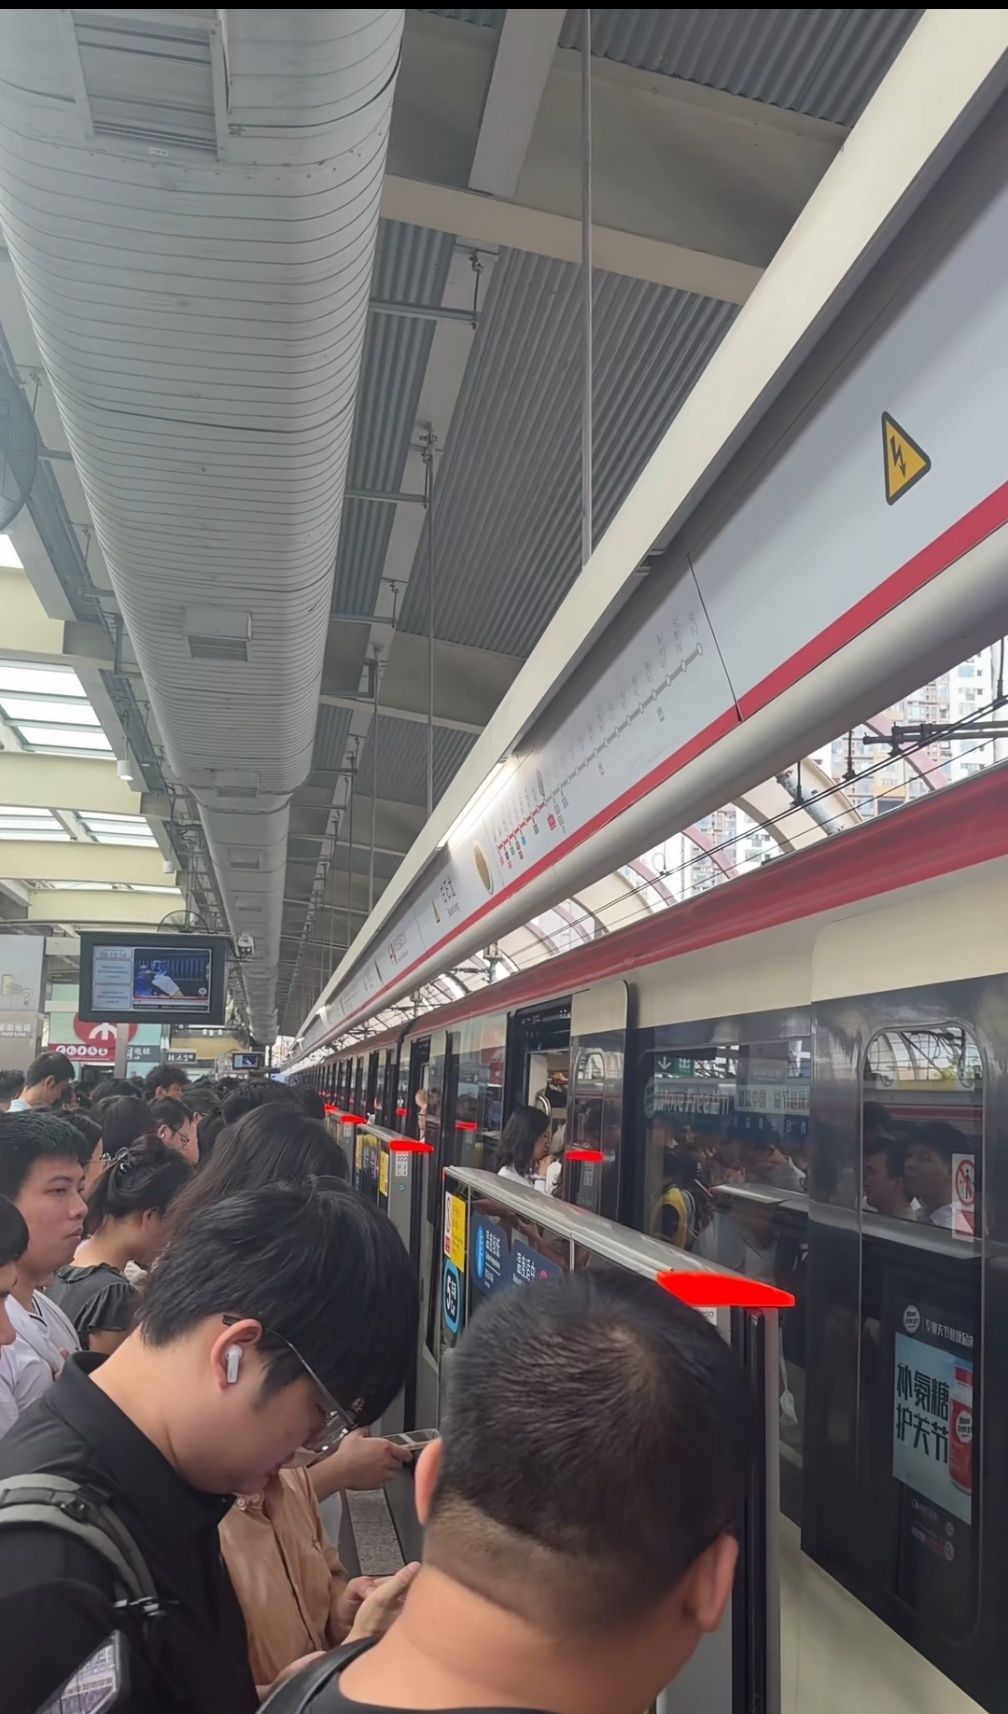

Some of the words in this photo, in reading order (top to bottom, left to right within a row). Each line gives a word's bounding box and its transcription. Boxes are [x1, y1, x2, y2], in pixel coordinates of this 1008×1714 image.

[896, 1362, 950, 1421] 补氨糖
[896, 1402, 950, 1465] 护关节
